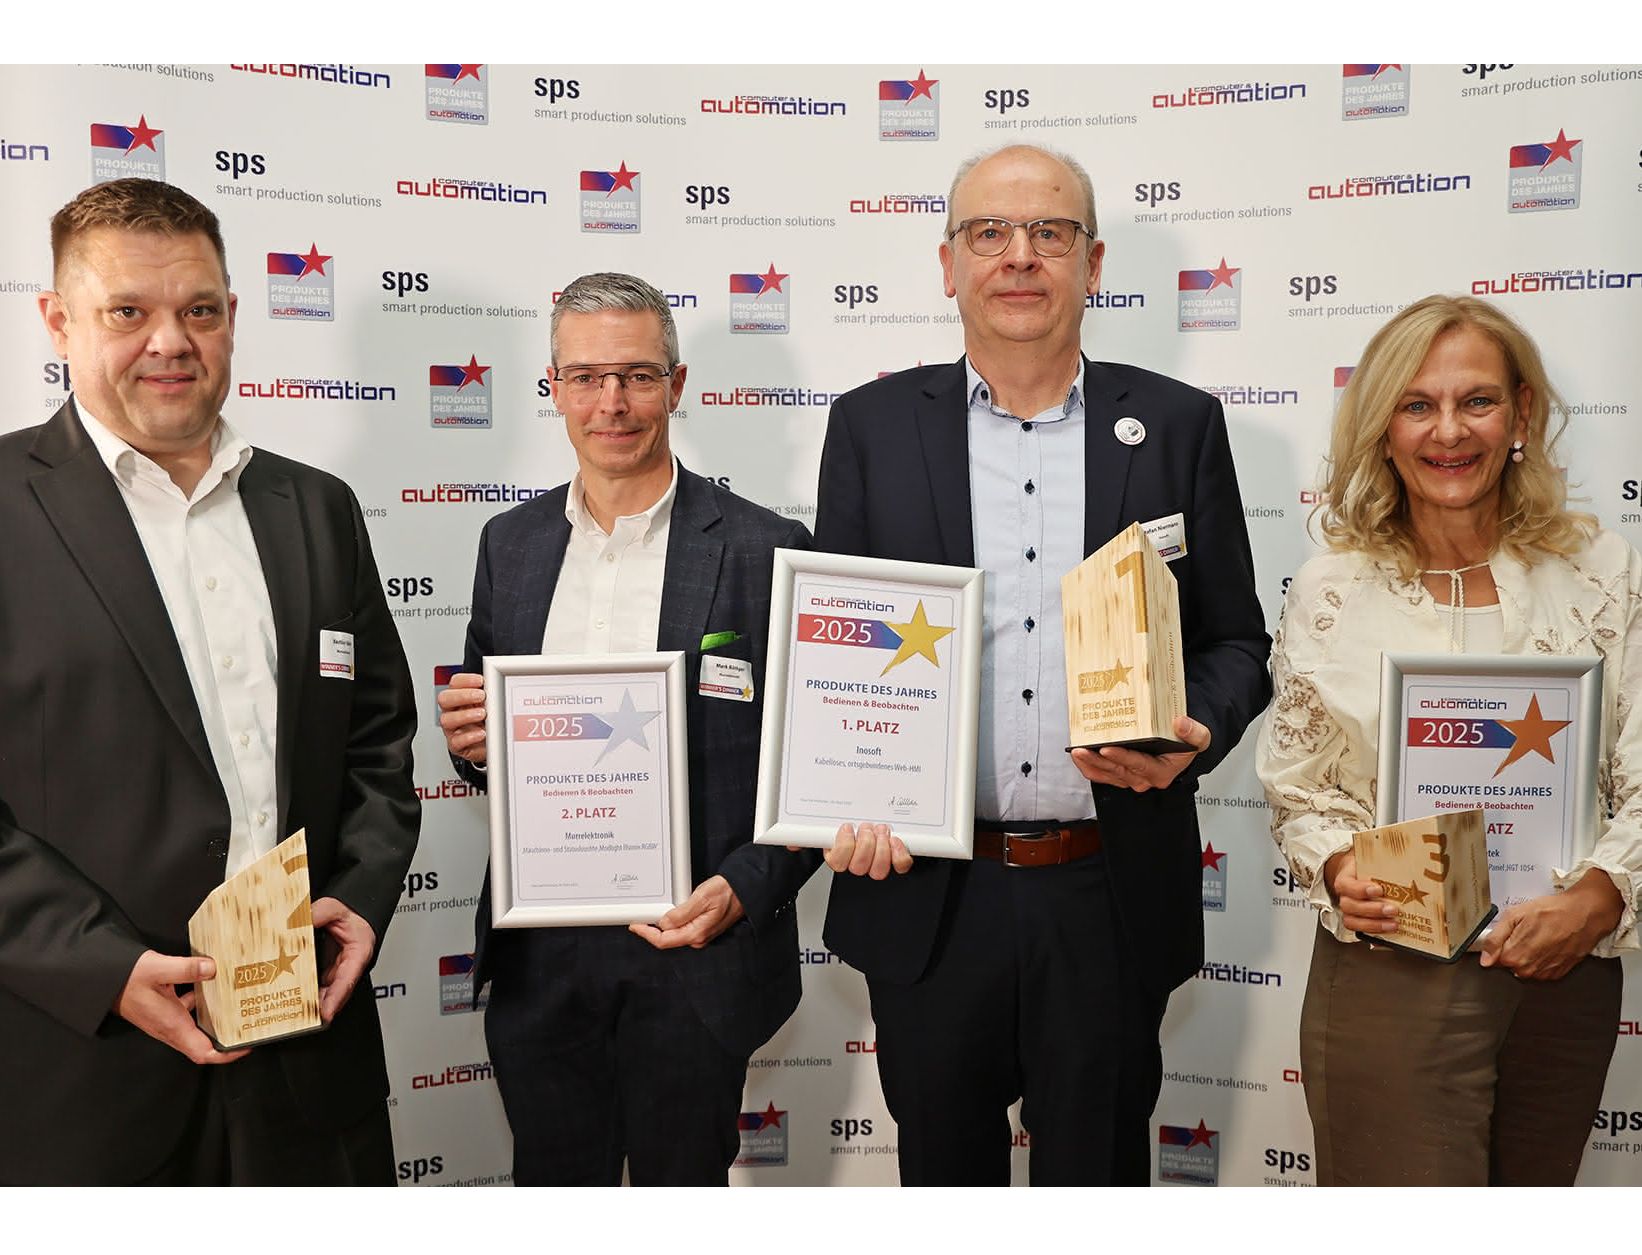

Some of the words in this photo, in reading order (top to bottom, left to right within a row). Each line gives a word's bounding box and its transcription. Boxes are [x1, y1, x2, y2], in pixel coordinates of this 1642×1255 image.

[157, 64, 215, 82] solutions
[534, 77, 580, 103] sps
[1461, 83, 1499, 97] smart
[1503, 74, 1576, 95] production
[984, 88, 1030, 113] sps
[1152, 82, 1306, 108] automation
[701, 95, 846, 115] automation
[534, 109, 567, 119] smart
[571, 110, 632, 123] production
[636, 112, 687, 126] solutions
[984, 118, 1017, 129] smart
[1020, 115, 1082, 130] production
[1085, 113, 1137, 126] solutions
[95, 158, 159, 173] PRODUKTE
[215, 150, 266, 179] sps
[1308, 173, 1470, 200] automation
[1512, 174, 1575, 186] PRODUKTE
[216, 182, 252, 197] smart
[257, 186, 324, 203] production
[327, 191, 382, 208] solutions
[397, 178, 547, 204] automation
[686, 184, 730, 210] sps
[1134, 180, 1181, 207] sps
[1512, 198, 1575, 208] automation
[686, 215, 718, 225] smart
[721, 215, 782, 228] production
[785, 215, 836, 227] solutions
[1134, 212, 1168, 223] smart
[1171, 208, 1235, 224] production
[1239, 205, 1292, 218] solutions
[382, 270, 429, 298] sps
[1288, 274, 1338, 302] sps
[1472, 269, 1642, 296] automation
[834, 284, 879, 308] sps
[272, 307, 331, 317] automation
[383, 301, 416, 313] smart
[420, 302, 483, 318] production
[487, 304, 538, 318] solutions
[1288, 305, 1323, 317] smart
[1327, 302, 1394, 318] production
[834, 315, 866, 324] smart
[870, 313, 930, 326] production
[239, 378, 395, 400] automation
[432, 395, 488, 405] PRODUKTE
[1566, 402, 1627, 415] solutions
[434, 415, 488, 425] automation
[387, 576, 434, 603] sps
[1114, 551, 1149, 633] 1
[811, 596, 895, 613] automation
[811, 618, 872, 644] 2025
[806, 680, 869, 694] PRODUKTE
[870, 683, 893, 696] DES
[894, 686, 937, 700] JAHRES
[523, 695, 603, 706] automation
[822, 696, 862, 707] Bedienen
[870, 700, 920, 712] Beobachten
[1082, 697, 1135, 711] PRODUKTE
[1420, 698, 1507, 711] automation
[1082, 711, 1100, 720] DES
[1102, 706, 1136, 718] JAHRES
[527, 716, 583, 738] 2025
[841, 719, 853, 731] 1.
[856, 719, 900, 735] PLATZ
[1422, 722, 1484, 745] 2025
[856, 746, 882, 756] Inosoft
[526, 774, 584, 785] PRODUKTE
[586, 773, 607, 784] DES
[609, 772, 650, 783] JAHRES
[542, 789, 579, 798] Bedienen
[580, 788, 587, 796] &
[588, 787, 634, 797] Beobachten
[1417, 784, 1481, 796] PRODUKTE
[1484, 786, 1506, 797] DES
[1508, 786, 1552, 797] JAHRES
[561, 808, 573, 820] 2.
[576, 807, 617, 819] PLATZ
[1434, 800, 1475, 809] Bedienen
[1476, 801, 1483, 809] &
[1484, 801, 1534, 811] Beobachten
[1422, 832, 1450, 883] 3
[1273, 897, 1305, 909] smart
[237, 970, 267, 984] 2025
[240, 987, 301, 1008] PRODUKTE
[241, 1004, 262, 1018] DES
[263, 998, 302, 1013] JAHRES
[784, 1056, 832, 1067] solutions
[1216, 1078, 1268, 1092] solutions
[830, 1119, 873, 1141] sps
[830, 1145, 861, 1155] smart
[1592, 1140, 1630, 1152] smart
[1264, 1148, 1310, 1174] sps
[397, 1156, 443, 1184] sps
